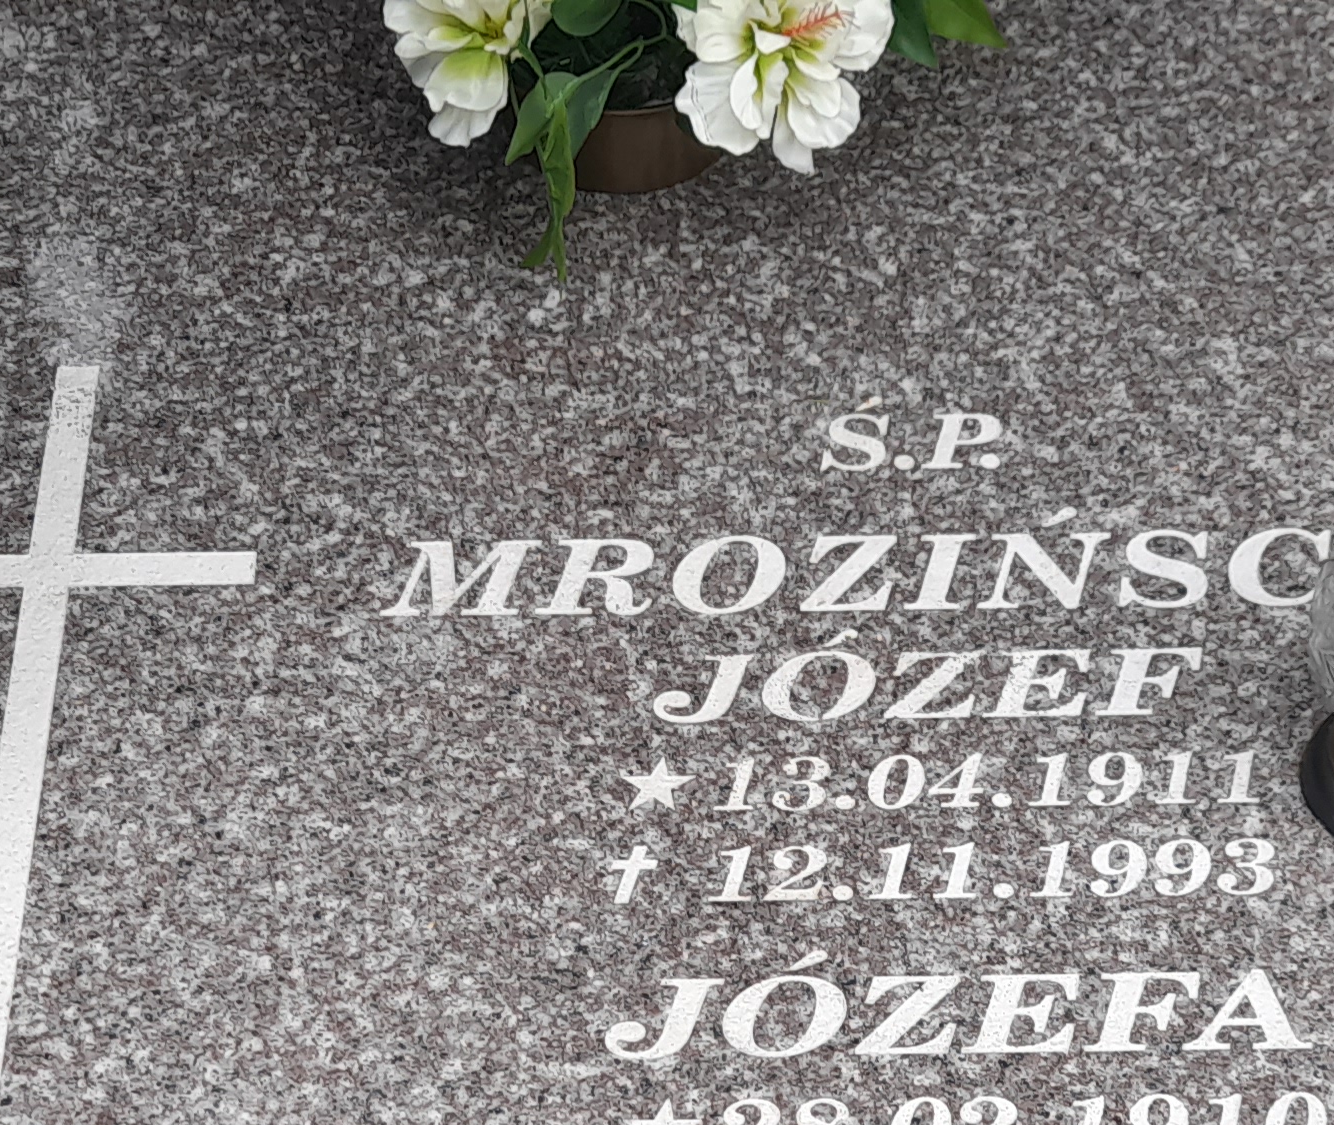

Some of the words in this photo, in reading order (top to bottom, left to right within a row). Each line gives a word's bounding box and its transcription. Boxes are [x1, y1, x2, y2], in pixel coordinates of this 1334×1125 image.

[821, 397, 1003, 473] Ś.P.
[651, 629, 1203, 726] JÓZEF
[713, 750, 1261, 814] 13.04.1911
[705, 838, 1279, 904] 12.11.1993
[604, 950, 1313, 1060] JÓZEFA
